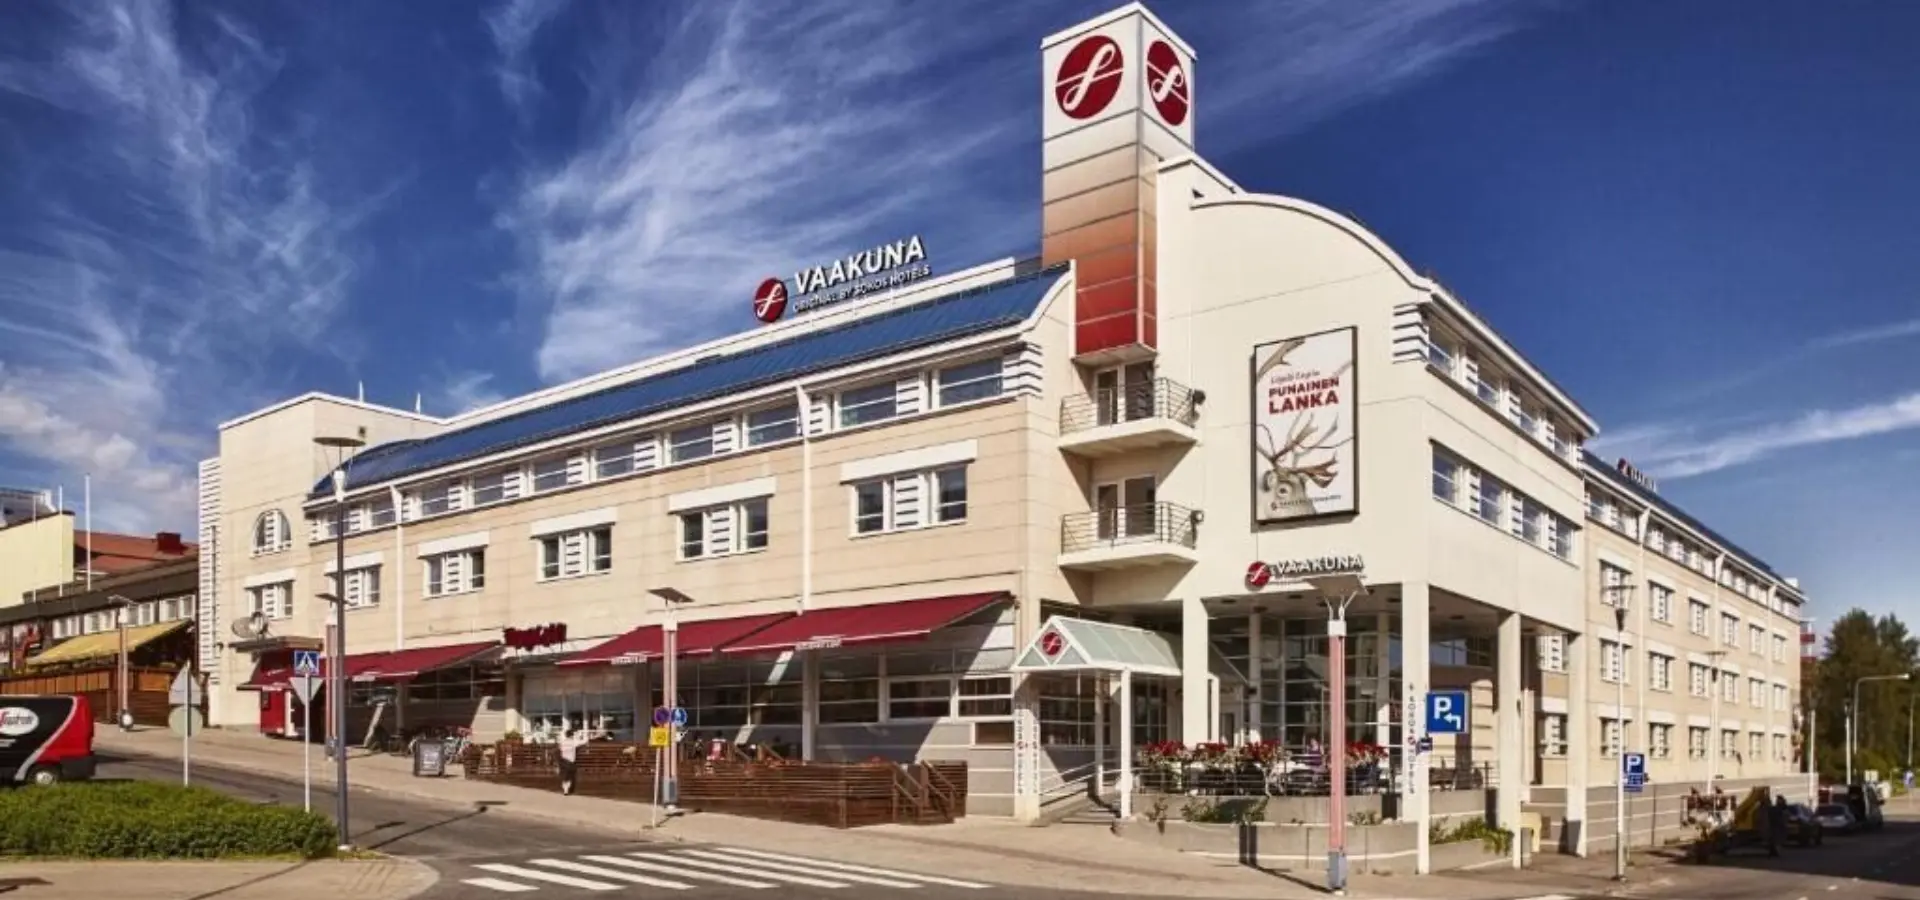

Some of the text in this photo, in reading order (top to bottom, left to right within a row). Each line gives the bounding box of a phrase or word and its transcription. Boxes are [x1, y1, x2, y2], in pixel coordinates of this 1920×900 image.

[794, 234, 927, 295] VAAKUNA
[839, 286, 854, 300] BY
[854, 278, 888, 297] SOKOS
[890, 264, 931, 286] HOTELS
[1268, 376, 1340, 398] PUNAINEN
[1268, 390, 1339, 415] LANKA
[1276, 553, 1363, 575] VAAKUNA
[1434, 696, 1452, 720] P
[1627, 755, 1642, 774] P
